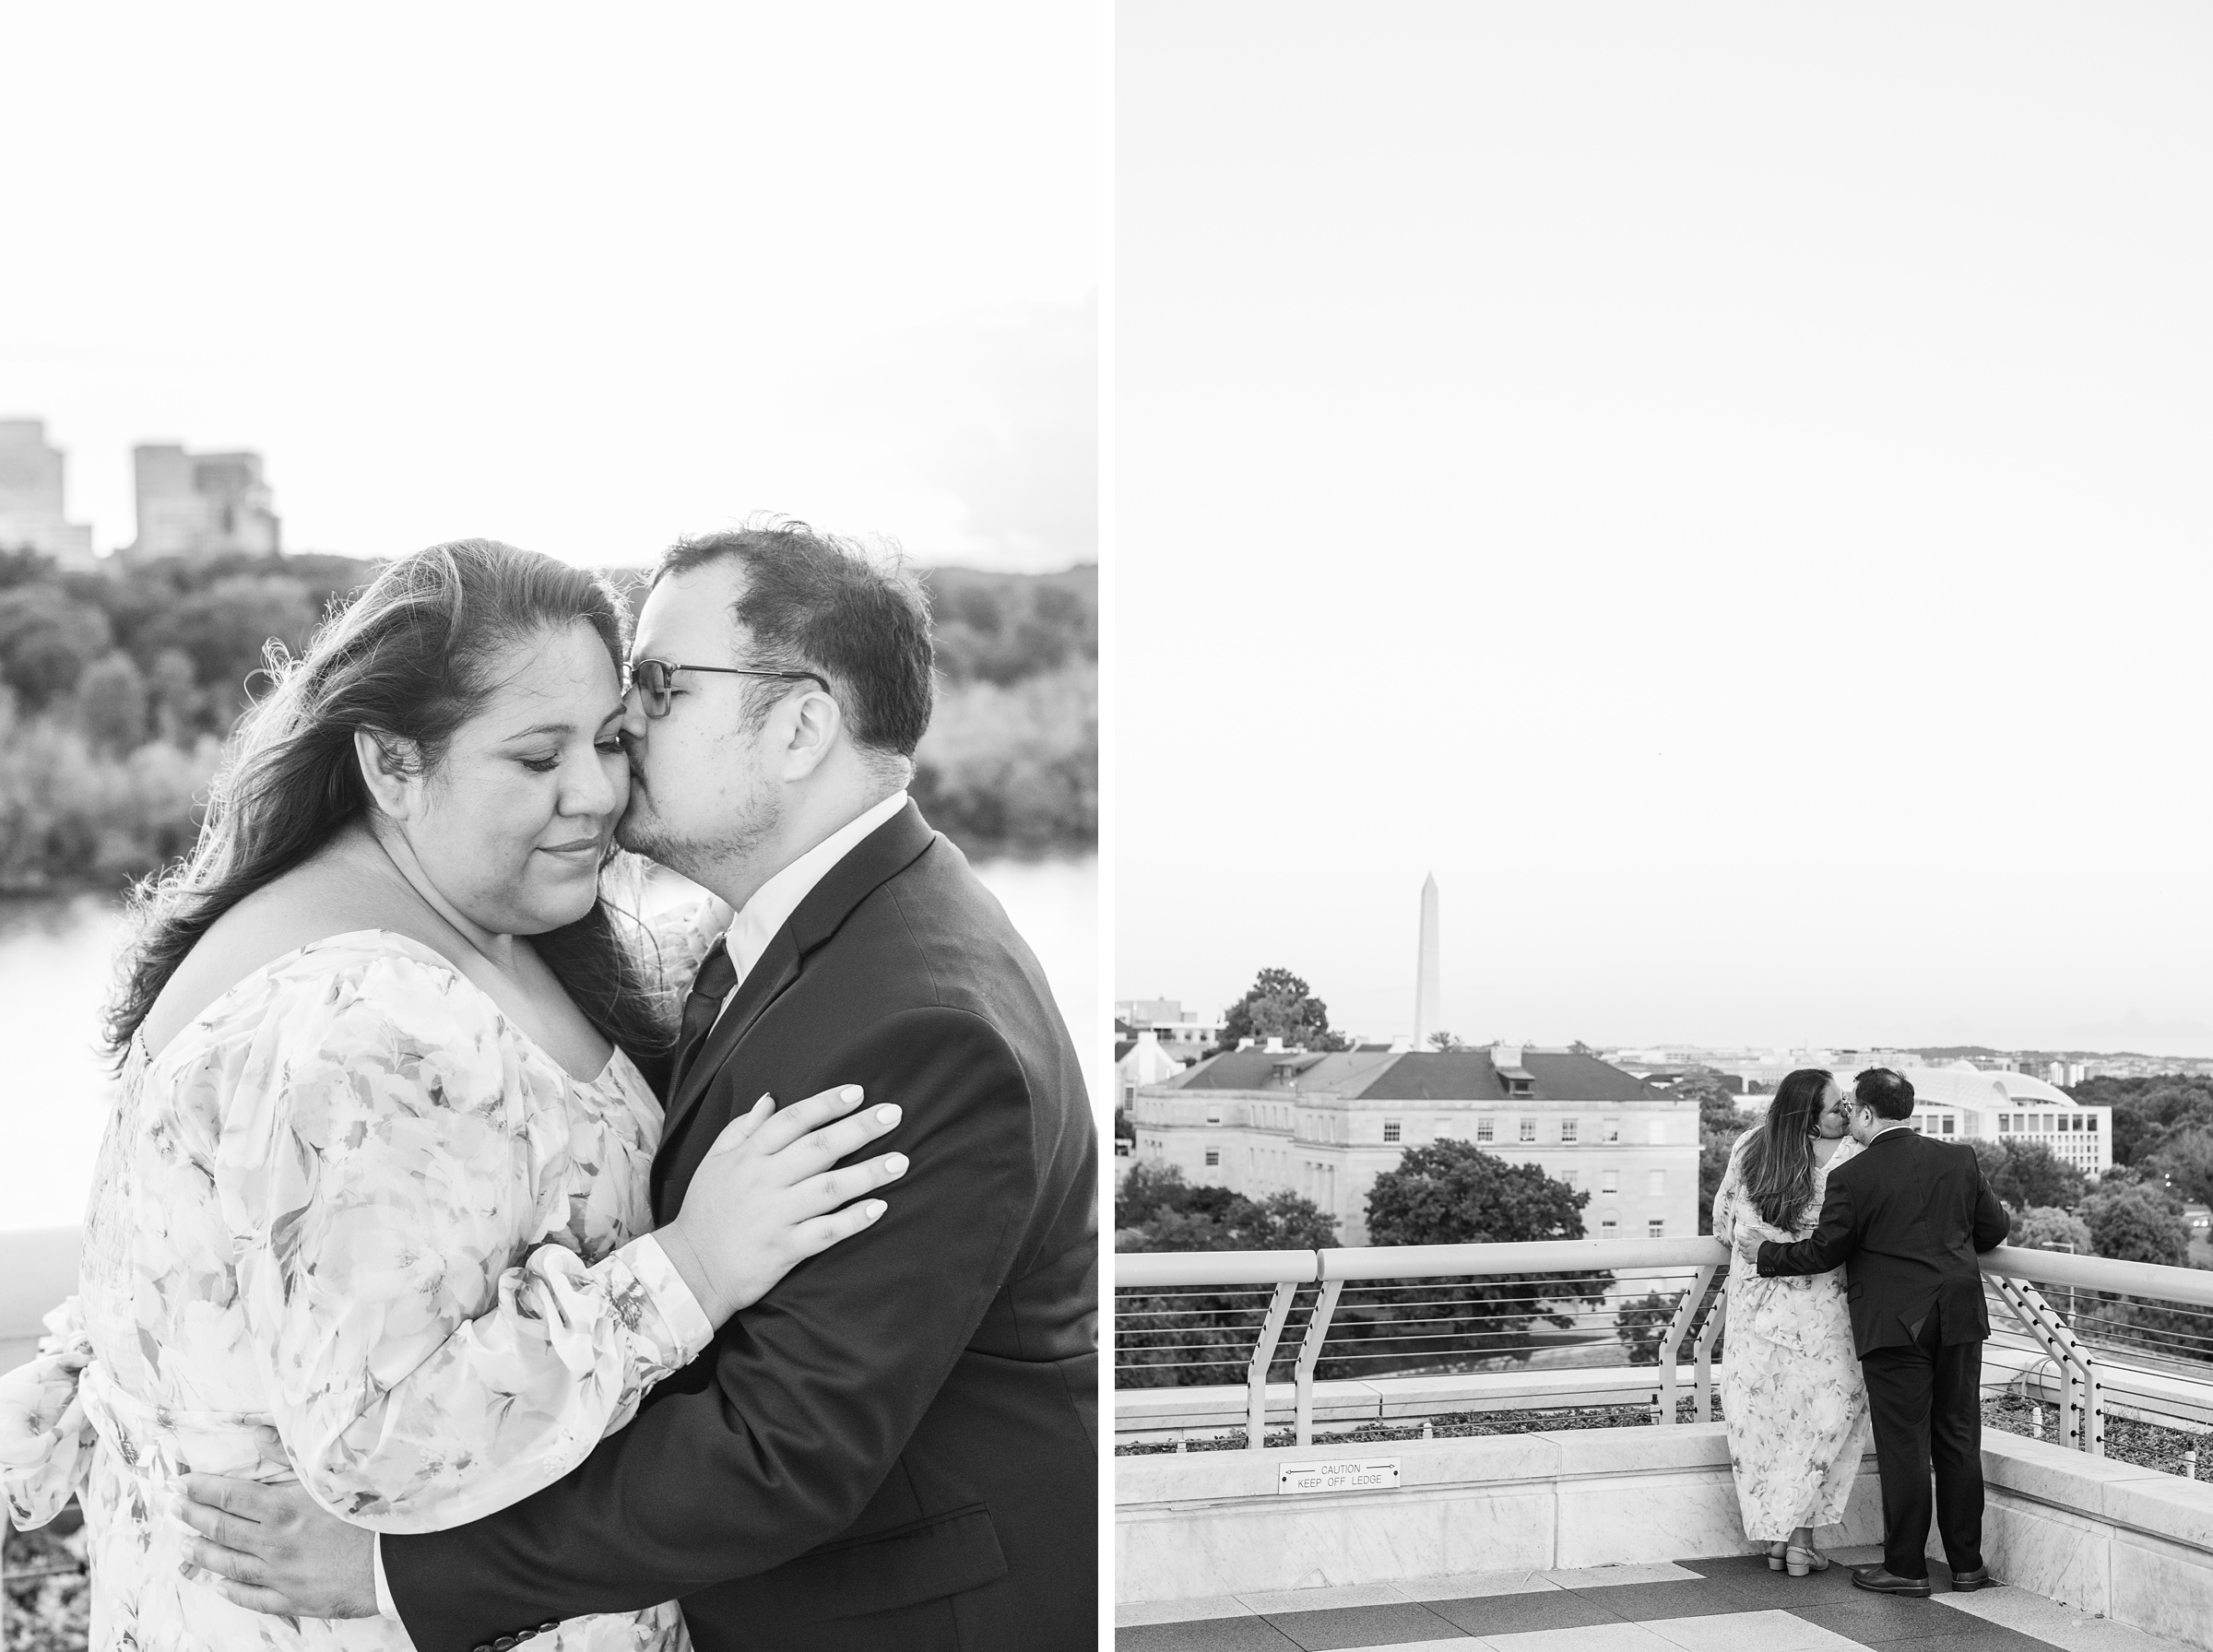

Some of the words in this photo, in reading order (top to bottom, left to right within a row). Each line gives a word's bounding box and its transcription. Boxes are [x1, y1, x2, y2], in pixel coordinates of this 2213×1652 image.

[1320, 1464, 1361, 1475] CAUTION
[1297, 1478, 1322, 1488] KEEP
[1327, 1477, 1346, 1487] OFF
[1352, 1475, 1382, 1485] LEDGE
